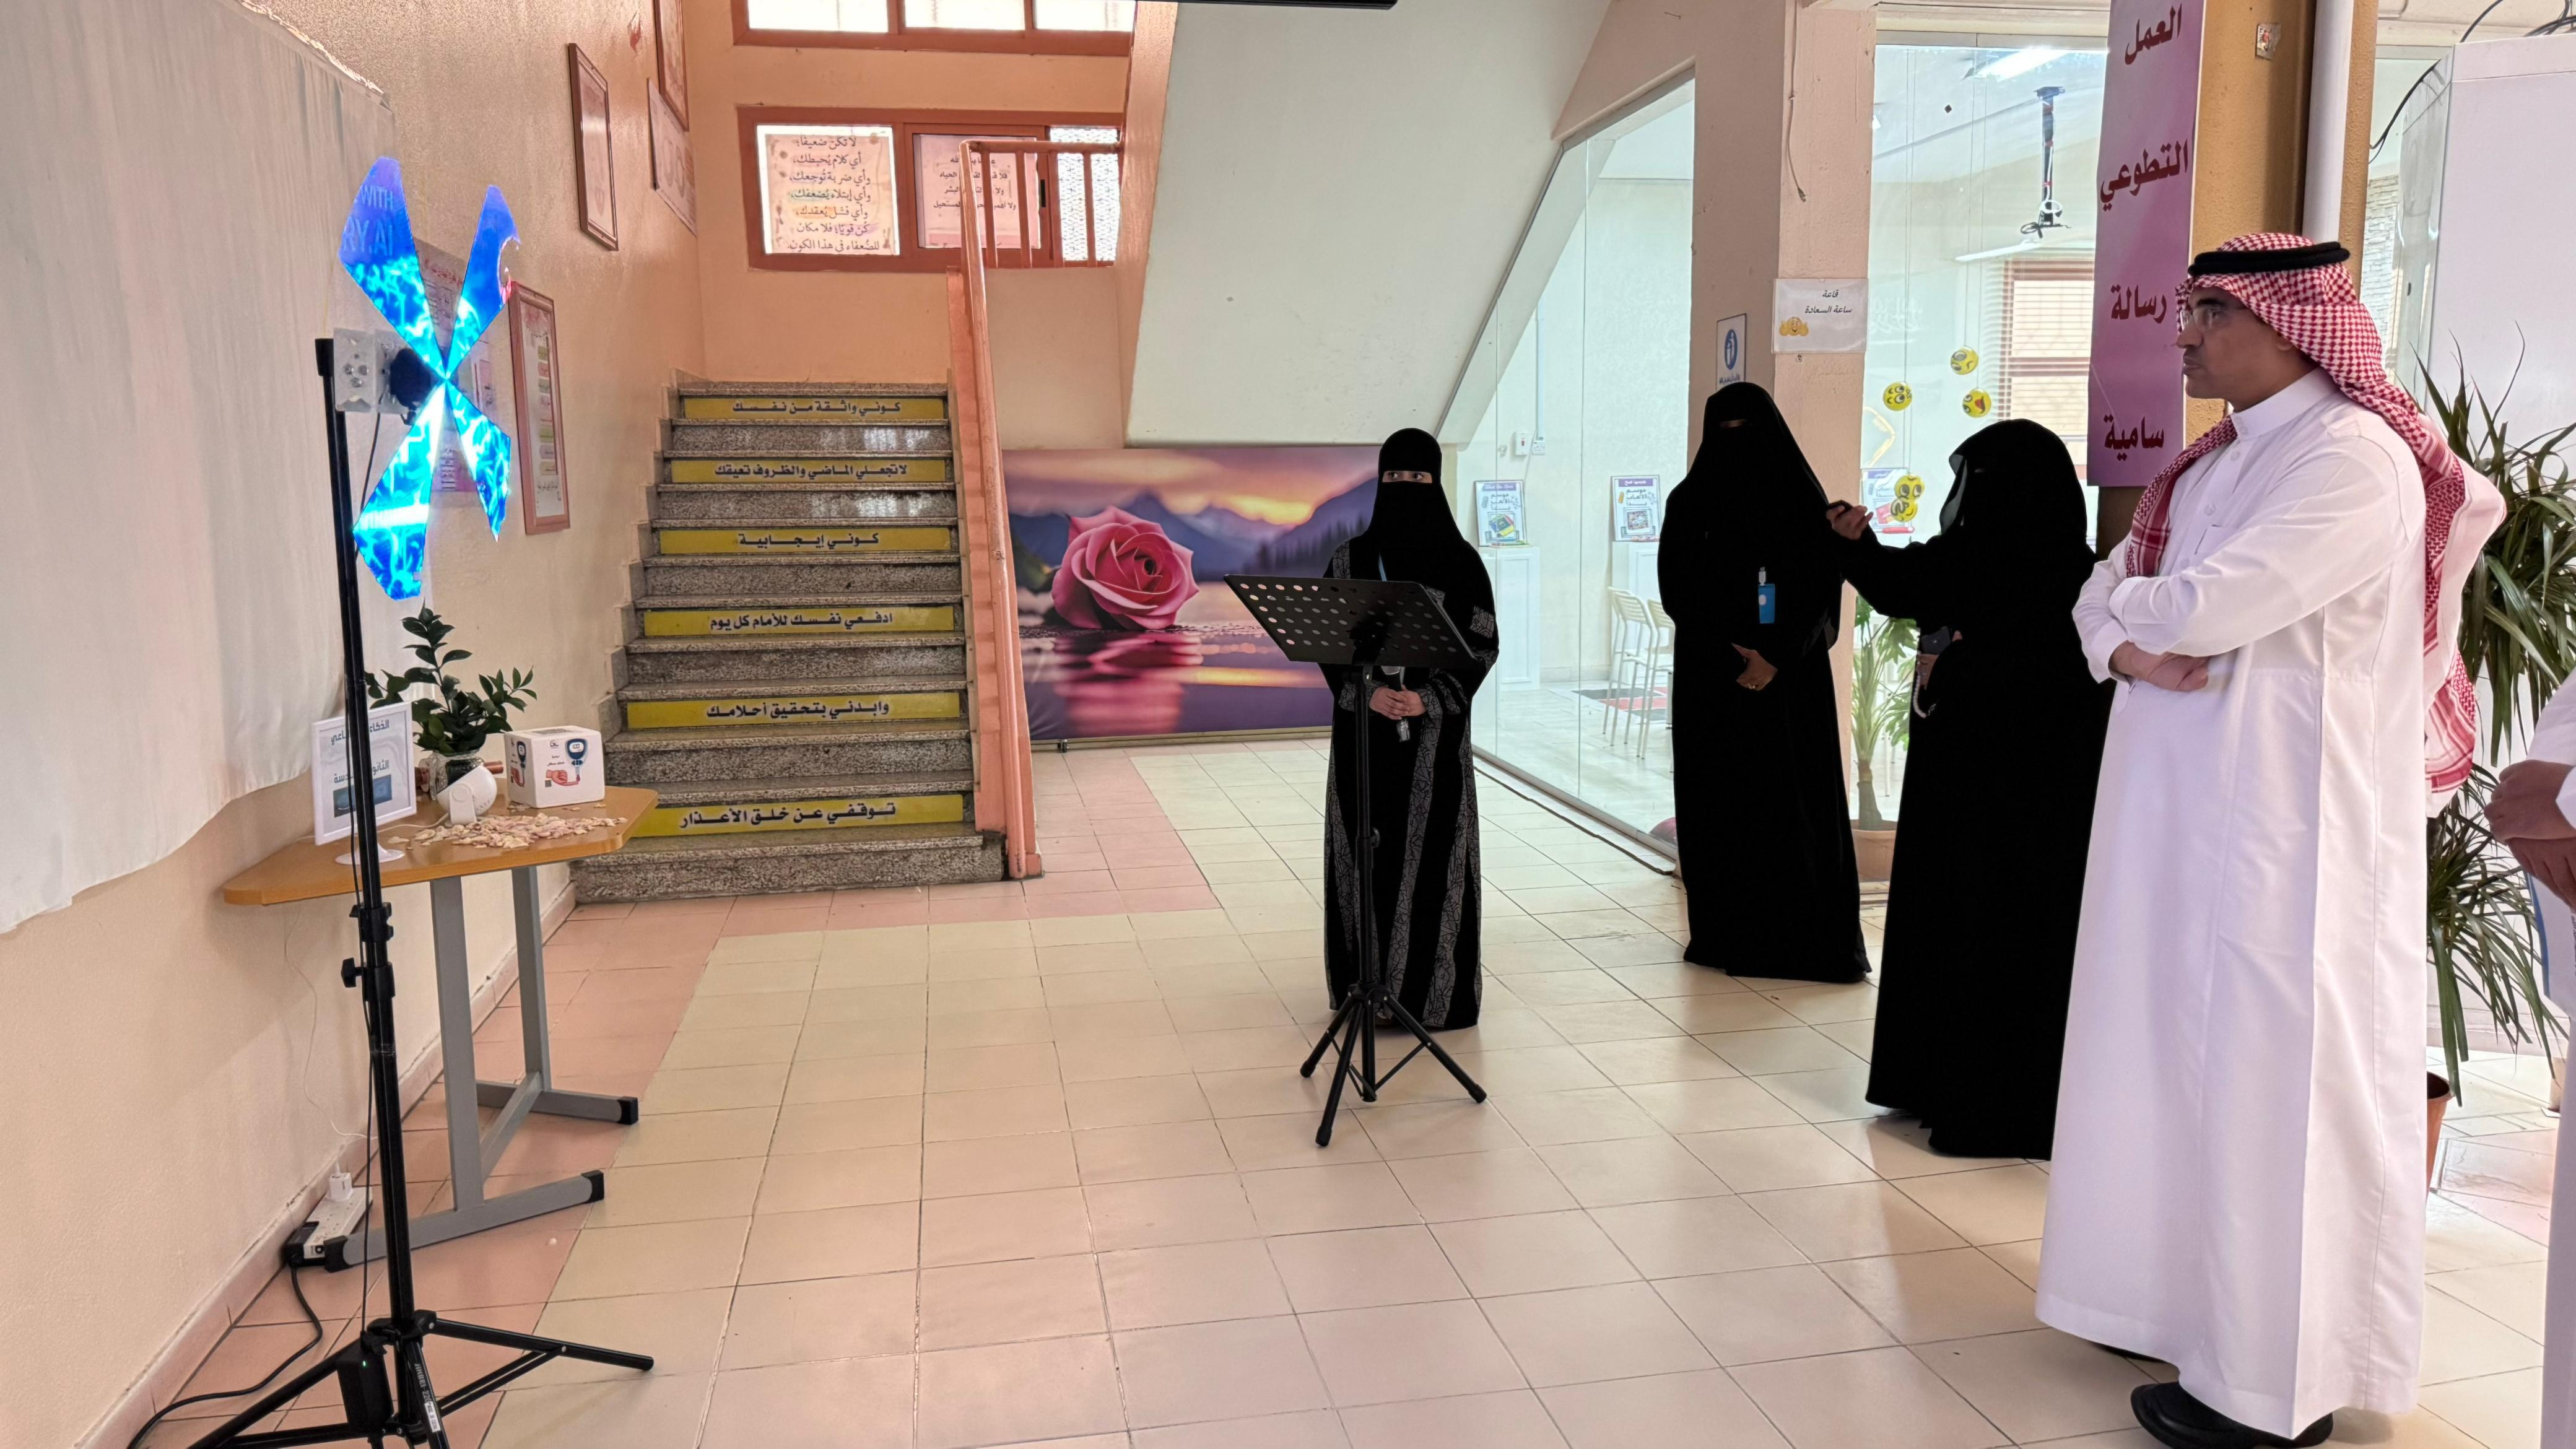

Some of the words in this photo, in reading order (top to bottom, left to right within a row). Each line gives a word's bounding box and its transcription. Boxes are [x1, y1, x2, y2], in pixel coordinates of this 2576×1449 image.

[2125, 3, 2182, 65] العمل
[829, 136, 847, 149] تكن
[832, 154, 849, 168] كلام
[854, 169, 871, 186] وأي
[2100, 138, 2188, 212] التطوعي
[360, 186, 393, 211] WITH
[854, 186, 871, 203] وأي
[851, 203, 868, 220] وأي
[797, 222, 819, 232] مكان
[817, 238, 833, 248] هذا
[1822, 289, 1839, 298] قاعة
[1804, 305, 1832, 313] السعادة
[1833, 305, 1853, 313] ساعة
[2110, 284, 2167, 324] رسالة
[732, 401, 787, 412] نفسك
[789, 402, 813, 414] من
[816, 399, 857, 414] واثقة
[858, 402, 900, 416] كوني
[2103, 414, 2164, 461] سامية
[715, 464, 751, 478] تعيقك
[752, 464, 806, 478] والظروف
[807, 464, 853, 480] الماضي
[739, 533, 825, 549] إيجابية
[827, 533, 879, 549] كوني
[710, 619, 732, 631] يوم
[734, 614, 750, 629] كل
[752, 612, 787, 629] للأمام
[791, 612, 842, 625] نفسك
[845, 611, 892, 629] ادفعي
[706, 702, 767, 718] أحلامك
[770, 702, 826, 718] بتحقيق
[679, 807, 747, 829] الأعذار
[751, 807, 790, 825] خلق
[793, 807, 823, 823] عن
[827, 802, 896, 824] توقفي
